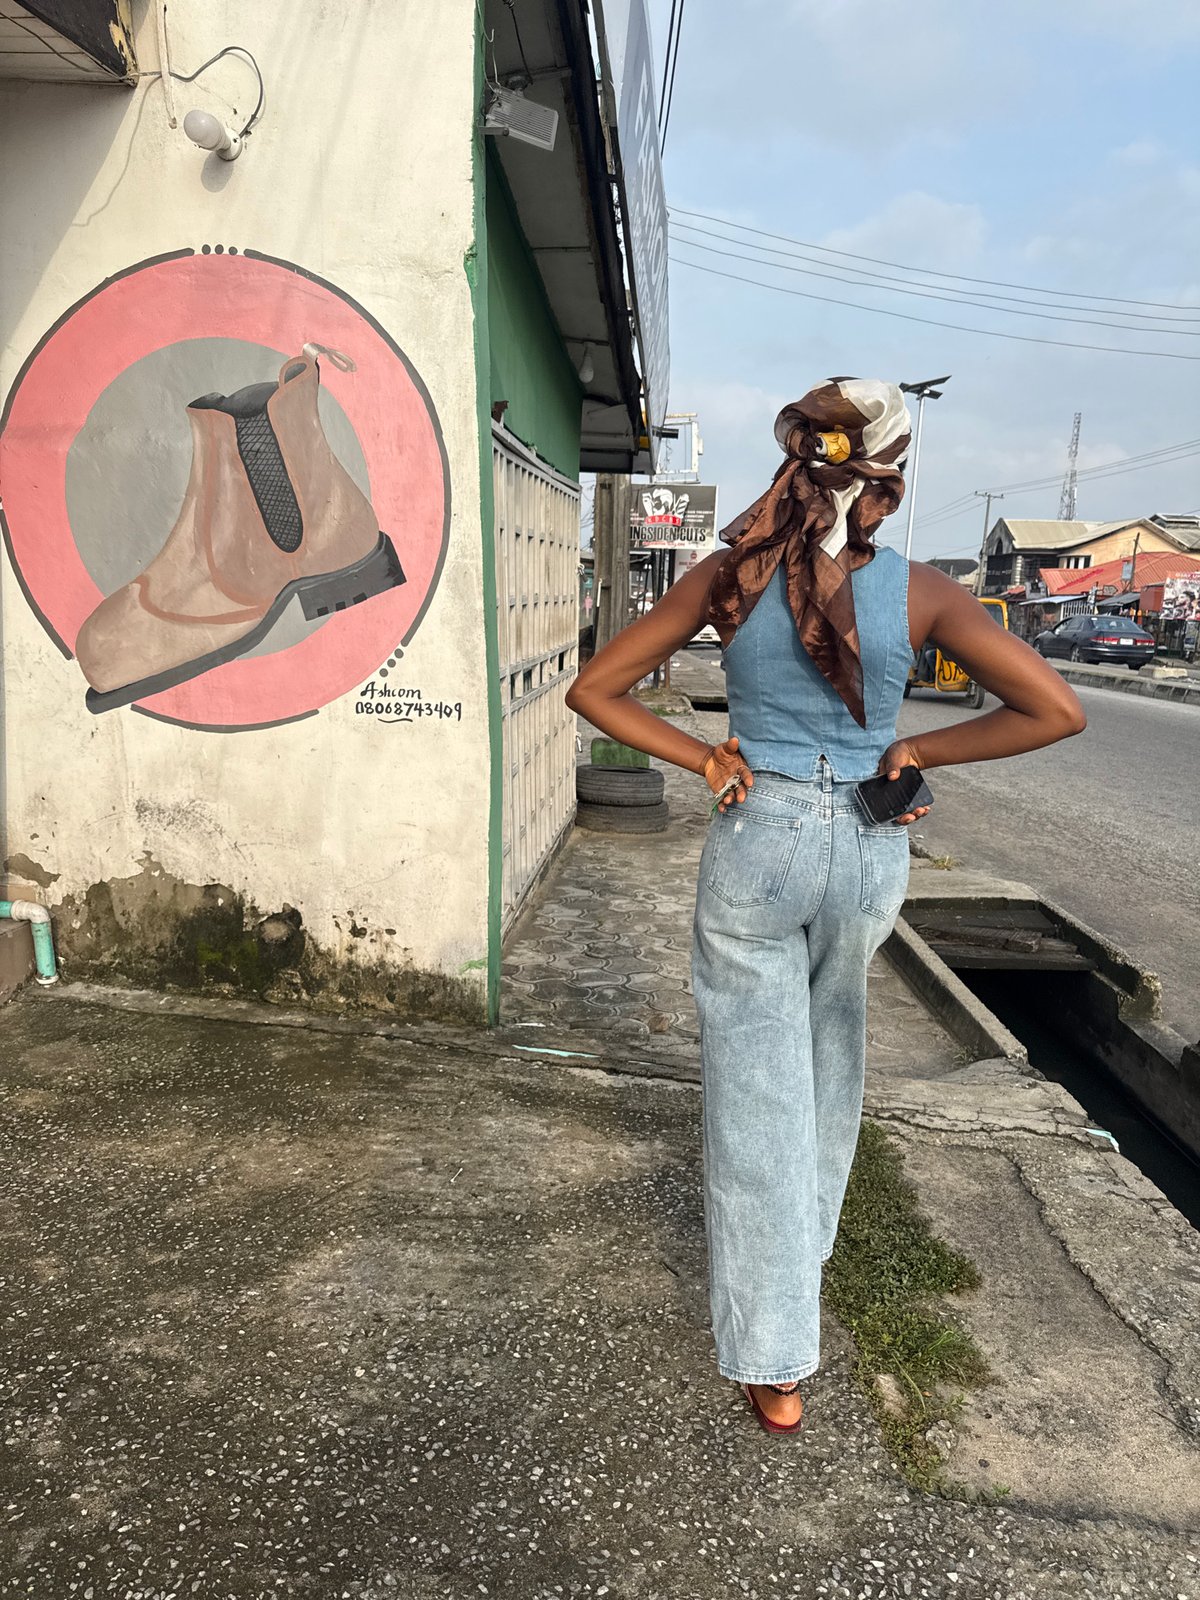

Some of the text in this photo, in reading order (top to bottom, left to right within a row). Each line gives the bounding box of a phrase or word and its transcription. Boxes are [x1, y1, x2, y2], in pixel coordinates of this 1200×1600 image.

[630, 526, 654, 541] INGS
[680, 527, 706, 543] CUTS
[360, 681, 422, 700] Ashcom
[355, 701, 462, 722] 08068743409
